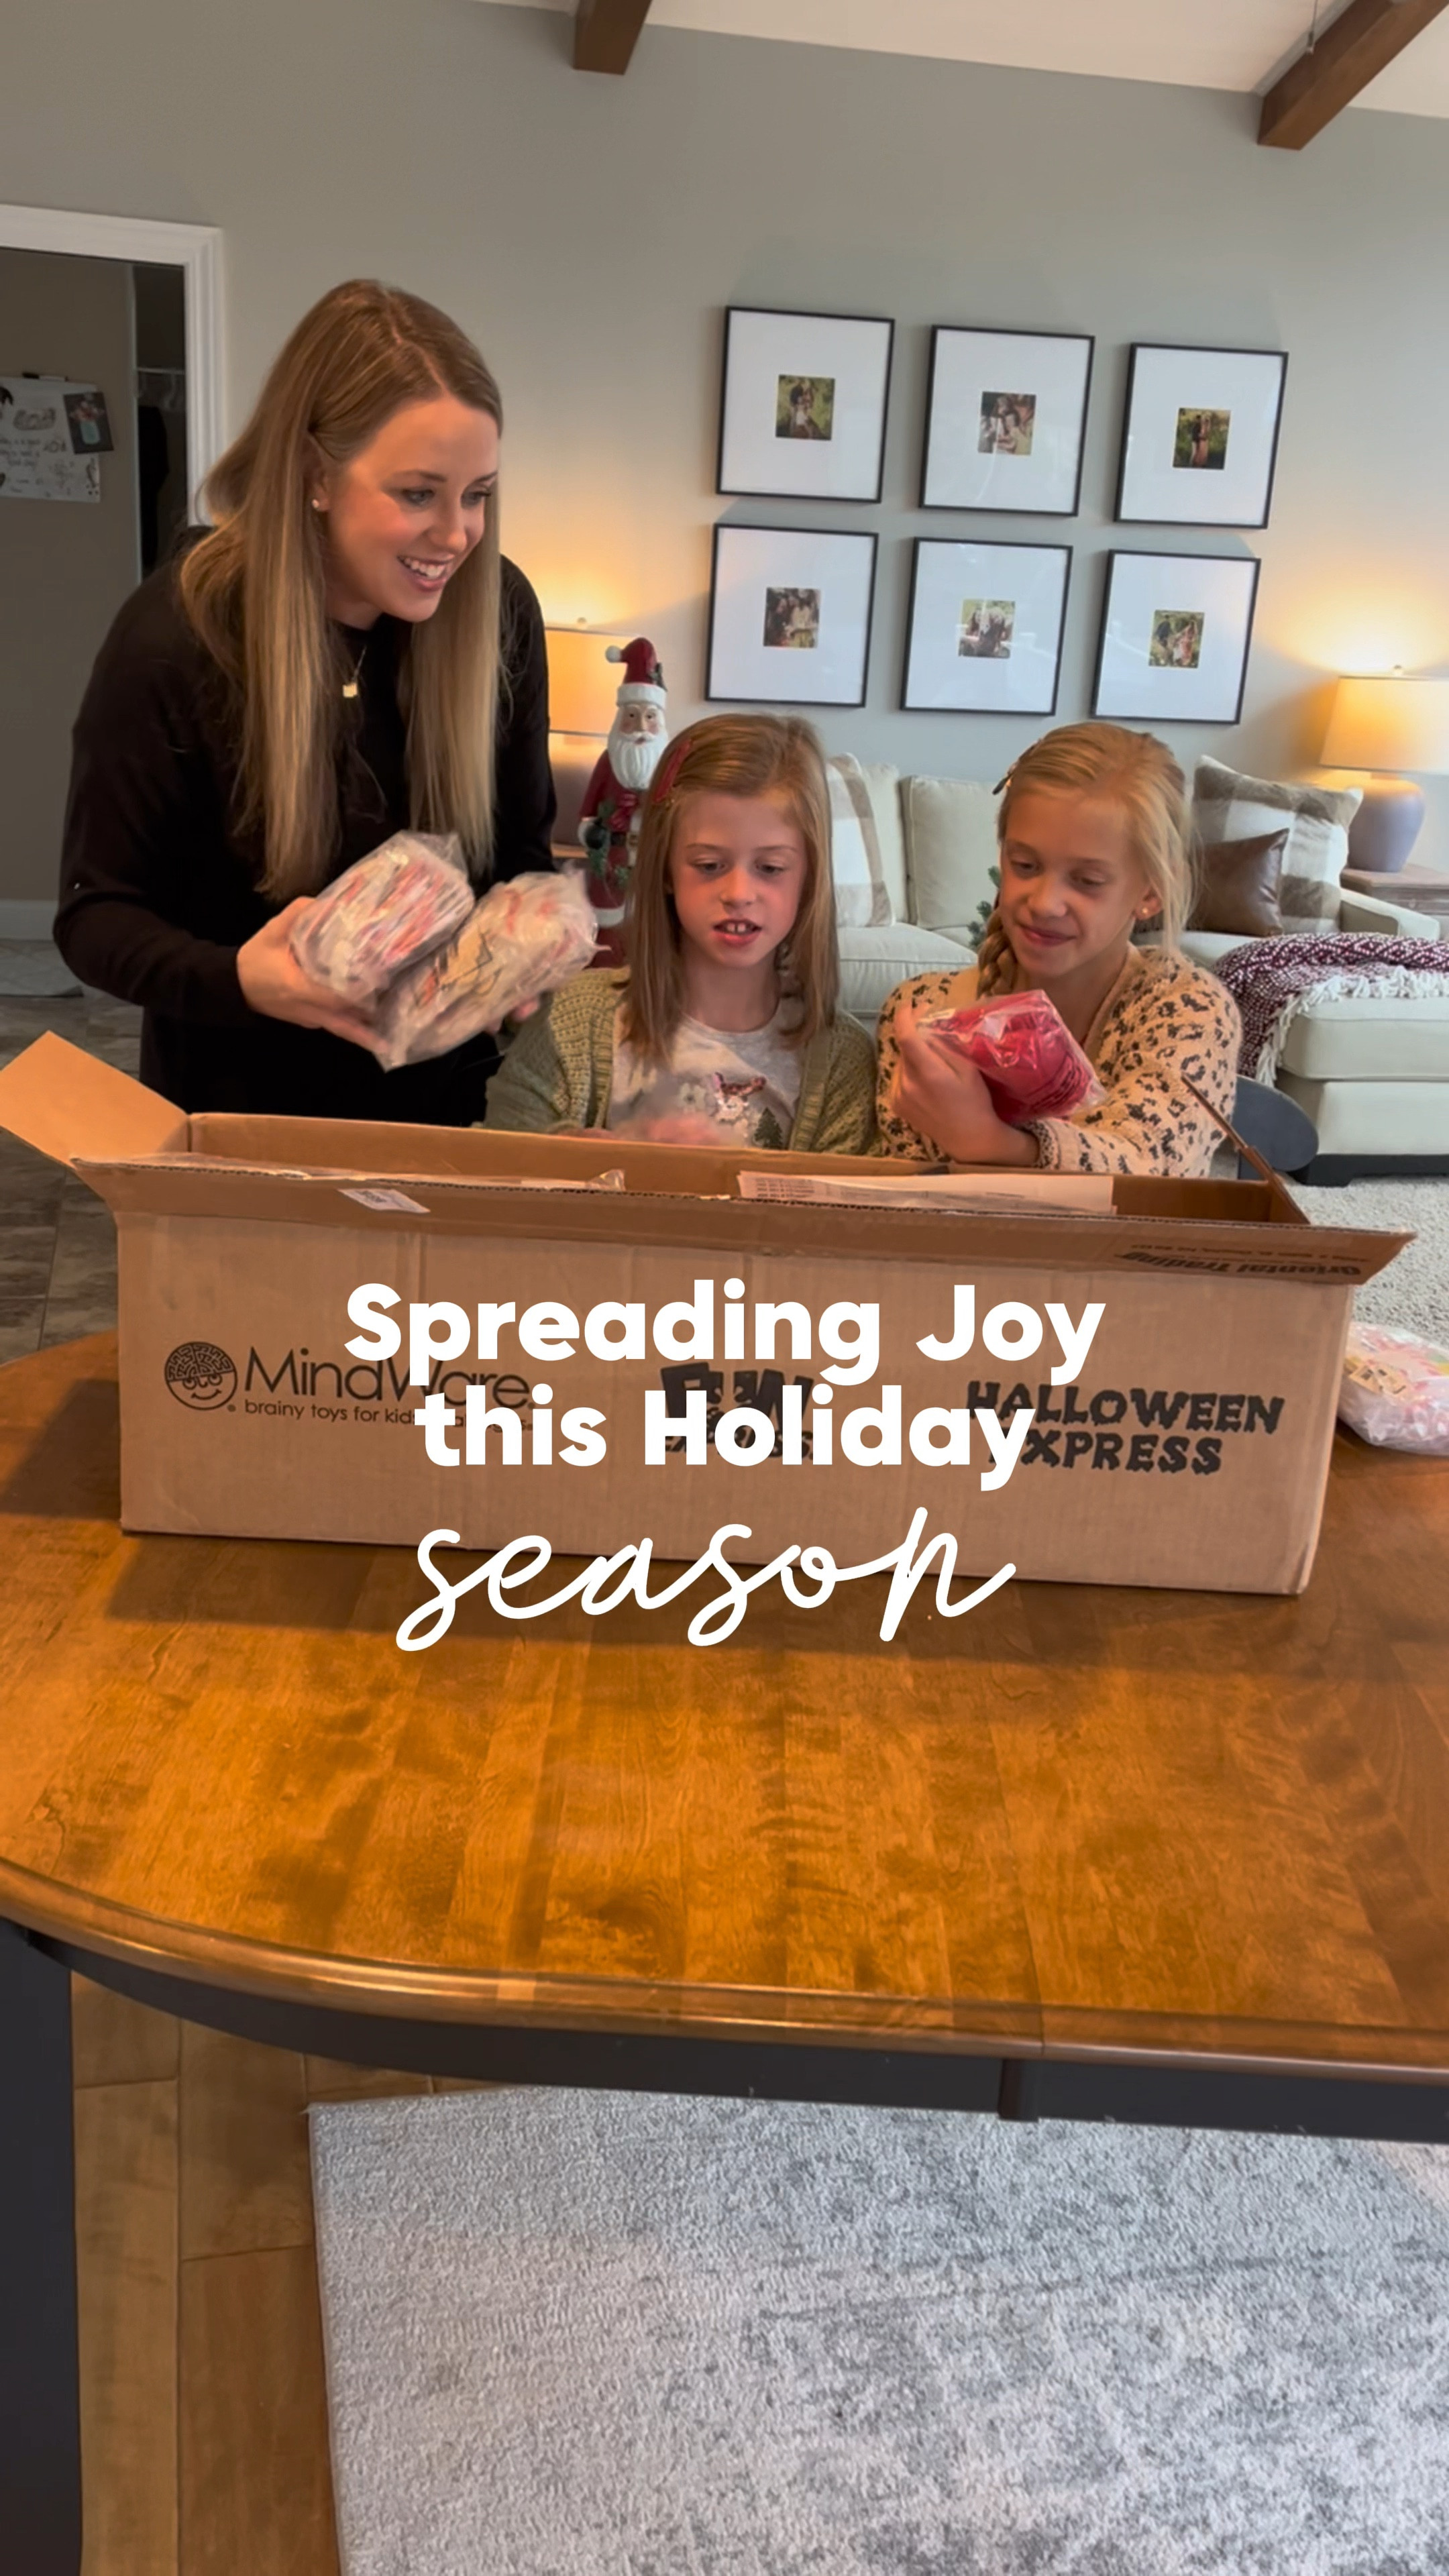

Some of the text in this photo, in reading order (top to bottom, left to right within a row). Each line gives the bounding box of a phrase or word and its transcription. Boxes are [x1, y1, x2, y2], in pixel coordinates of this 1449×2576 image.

[244, 1399, 416, 1426] brainy toys for kid
[966, 1380, 1285, 1435] HALLOWEEN
[989, 1427, 1223, 1476] XPRESS
